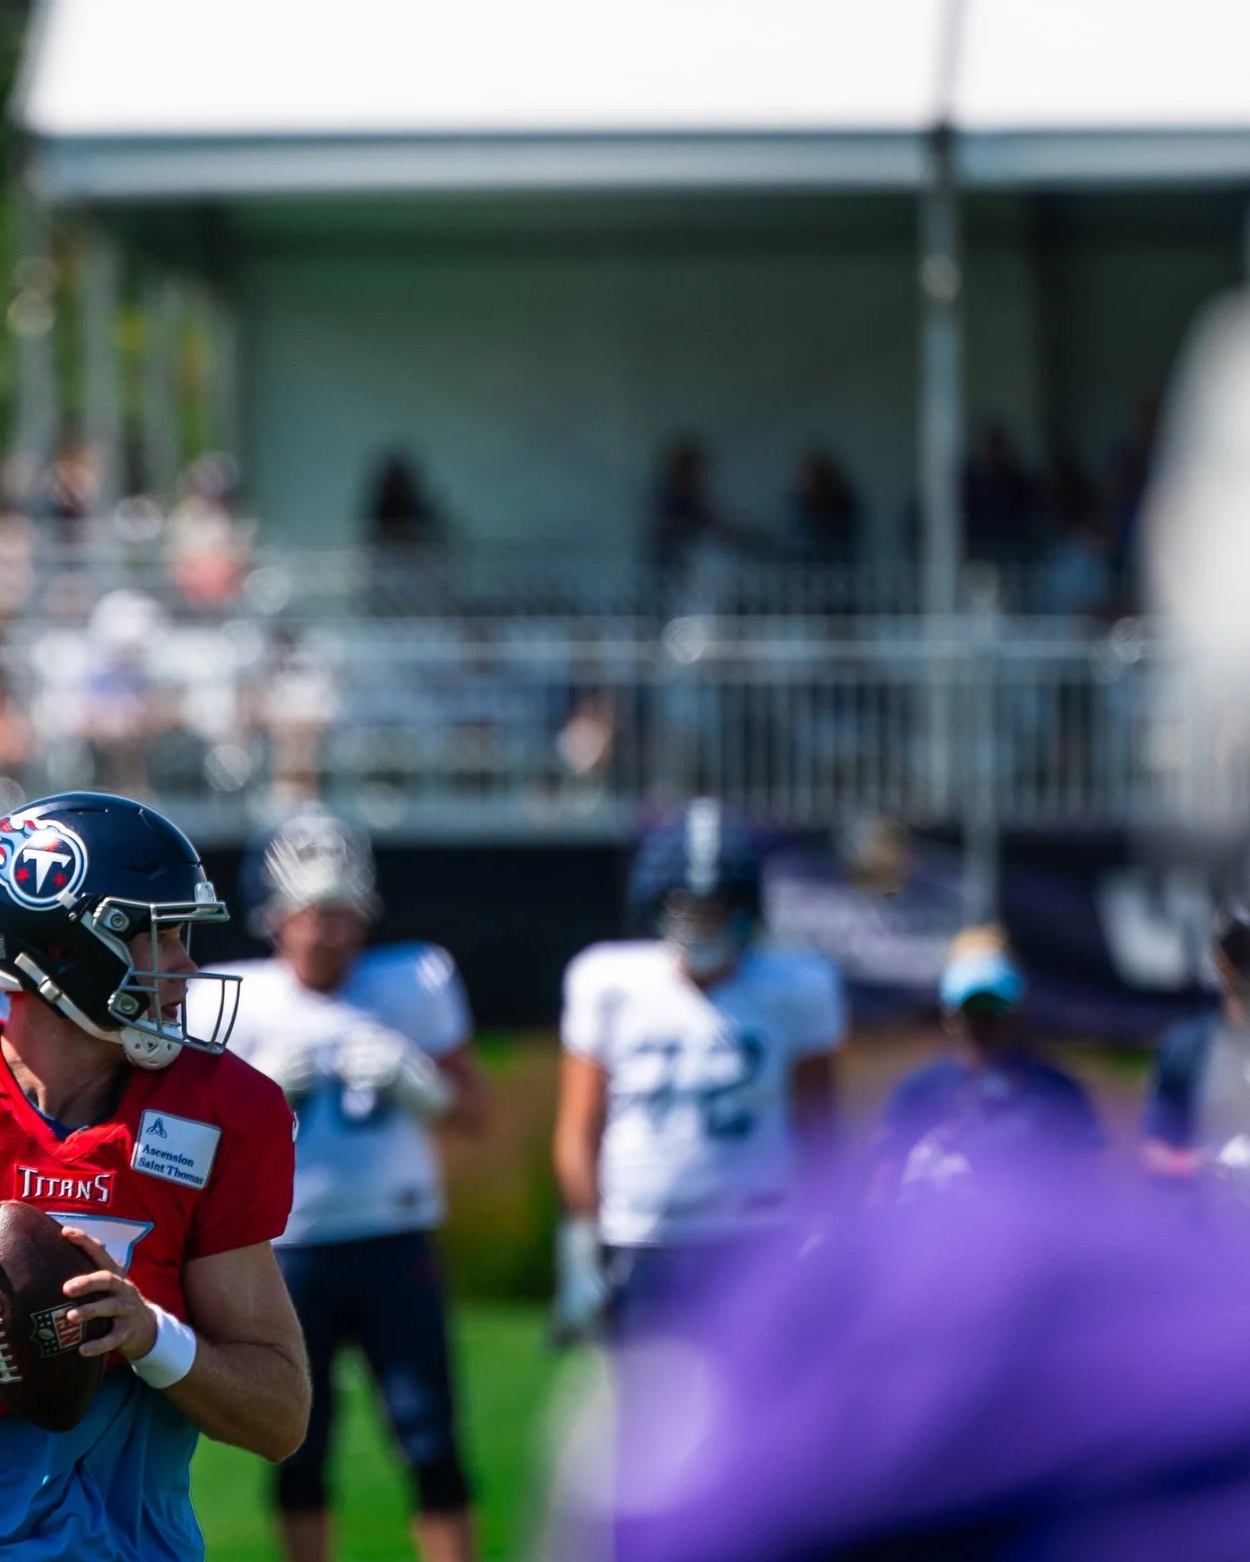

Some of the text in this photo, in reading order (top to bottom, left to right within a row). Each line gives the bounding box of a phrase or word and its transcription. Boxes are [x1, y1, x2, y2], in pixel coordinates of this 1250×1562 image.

[142, 1144, 195, 1167] Ascension
[18, 1166, 111, 1203] TITANS
[138, 1157, 204, 1185] Saint Thomas
